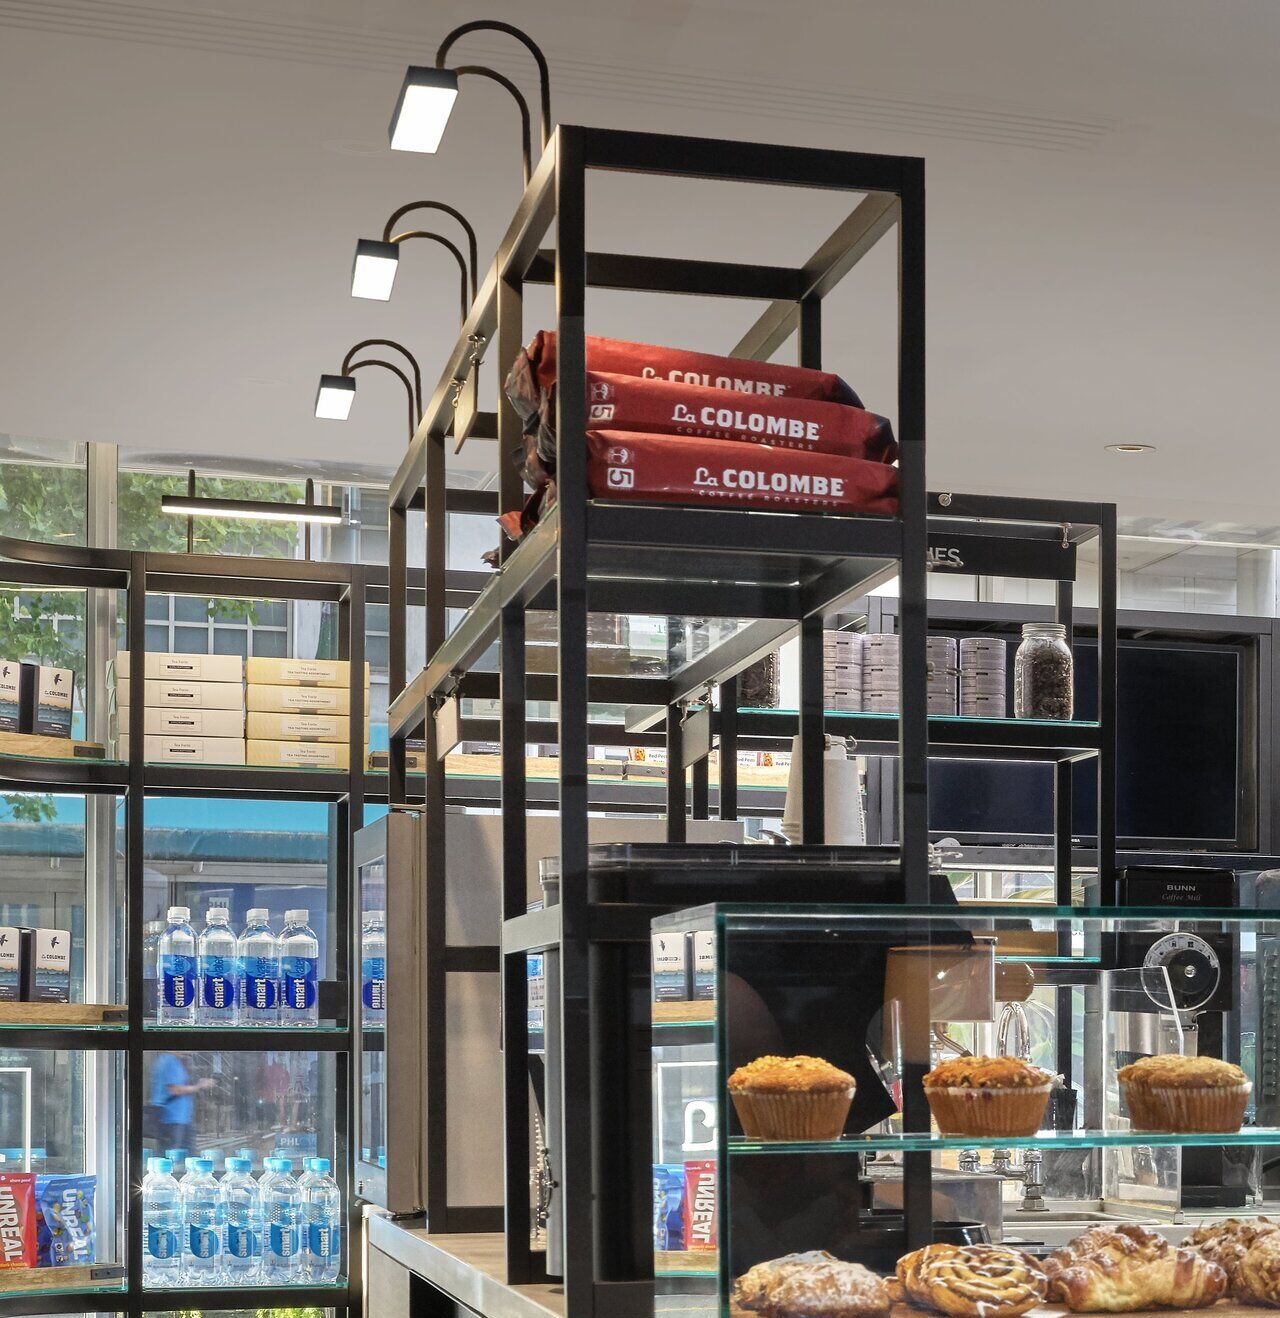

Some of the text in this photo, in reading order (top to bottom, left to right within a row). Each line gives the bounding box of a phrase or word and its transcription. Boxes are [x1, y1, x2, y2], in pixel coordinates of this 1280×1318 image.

[672, 404, 820, 441] La COLOMBE
[676, 426, 814, 451] COFFEE ROASTERS
[693, 467, 844, 497] La COLOMBE
[1166, 884, 1196, 892] BUNN
[174, 977, 186, 1009] smart
[214, 977, 225, 1009] smart
[256, 978, 266, 1010] smart
[295, 978, 305, 1009] smart
[0, 1187, 22, 1262] UNREAL
[62, 1188, 90, 1260] UNREAL
[321, 1228, 329, 1257] smart
